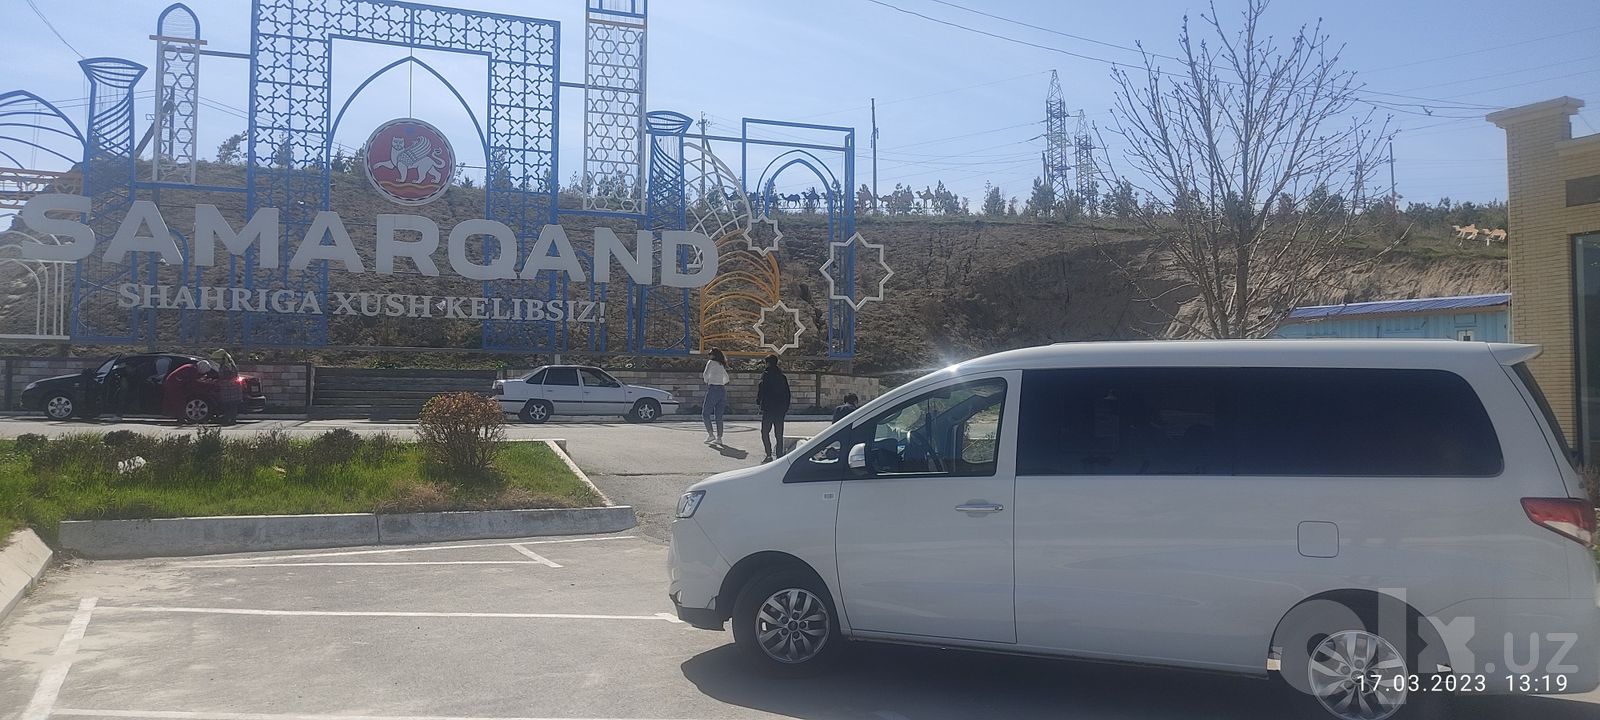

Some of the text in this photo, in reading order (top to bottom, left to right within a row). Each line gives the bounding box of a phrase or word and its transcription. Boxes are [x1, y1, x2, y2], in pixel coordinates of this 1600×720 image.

[21, 193, 719, 288] SAMARQAND
[118, 283, 606, 324] SHAHRIGA XUSH KELIBSIZ!
